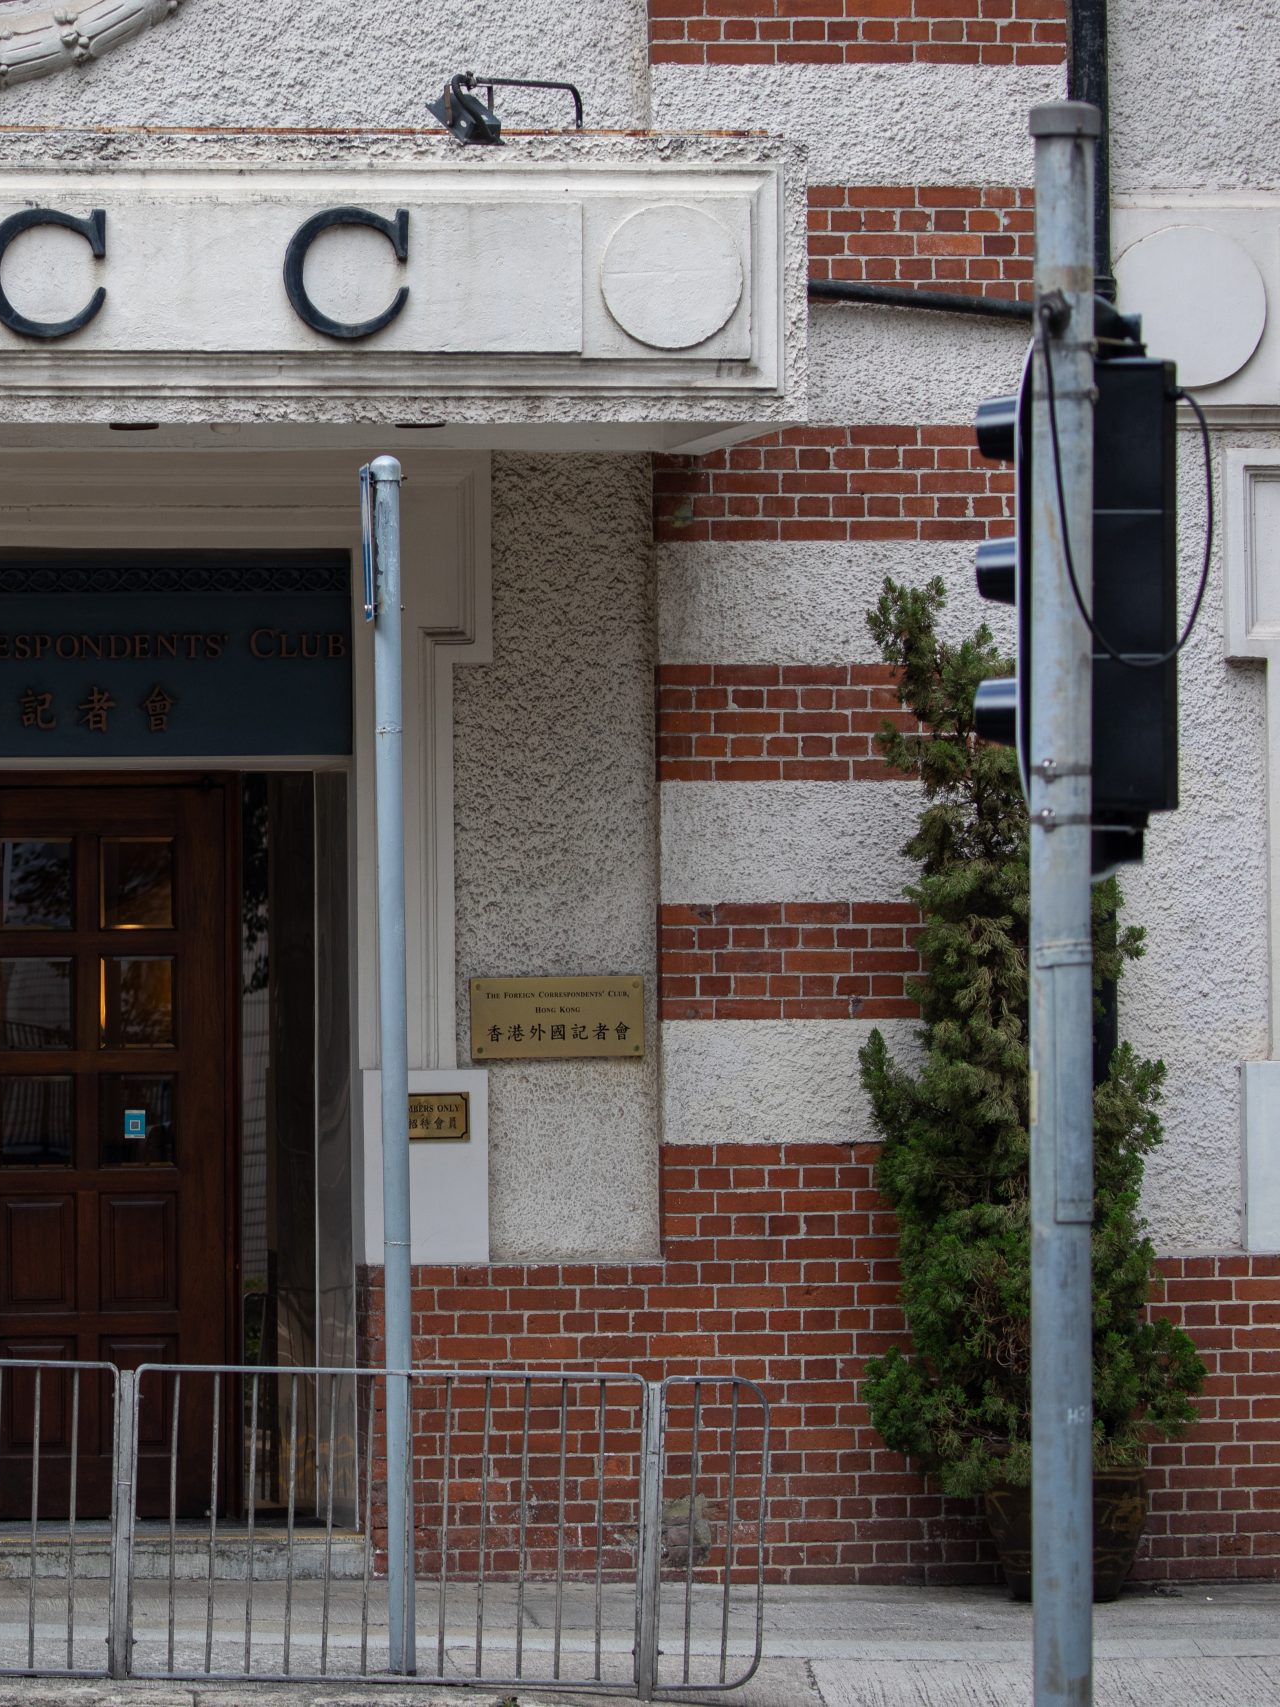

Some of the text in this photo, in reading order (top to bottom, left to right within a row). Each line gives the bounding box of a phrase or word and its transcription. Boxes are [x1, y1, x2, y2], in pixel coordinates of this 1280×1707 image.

[249, 627, 347, 659] CLUB
[504, 991, 535, 999] FOREIGN
[535, 1006, 556, 1014] HONG
[487, 1021, 631, 1043] 香港外國記者會
[437, 1103, 461, 1113] ONLY
